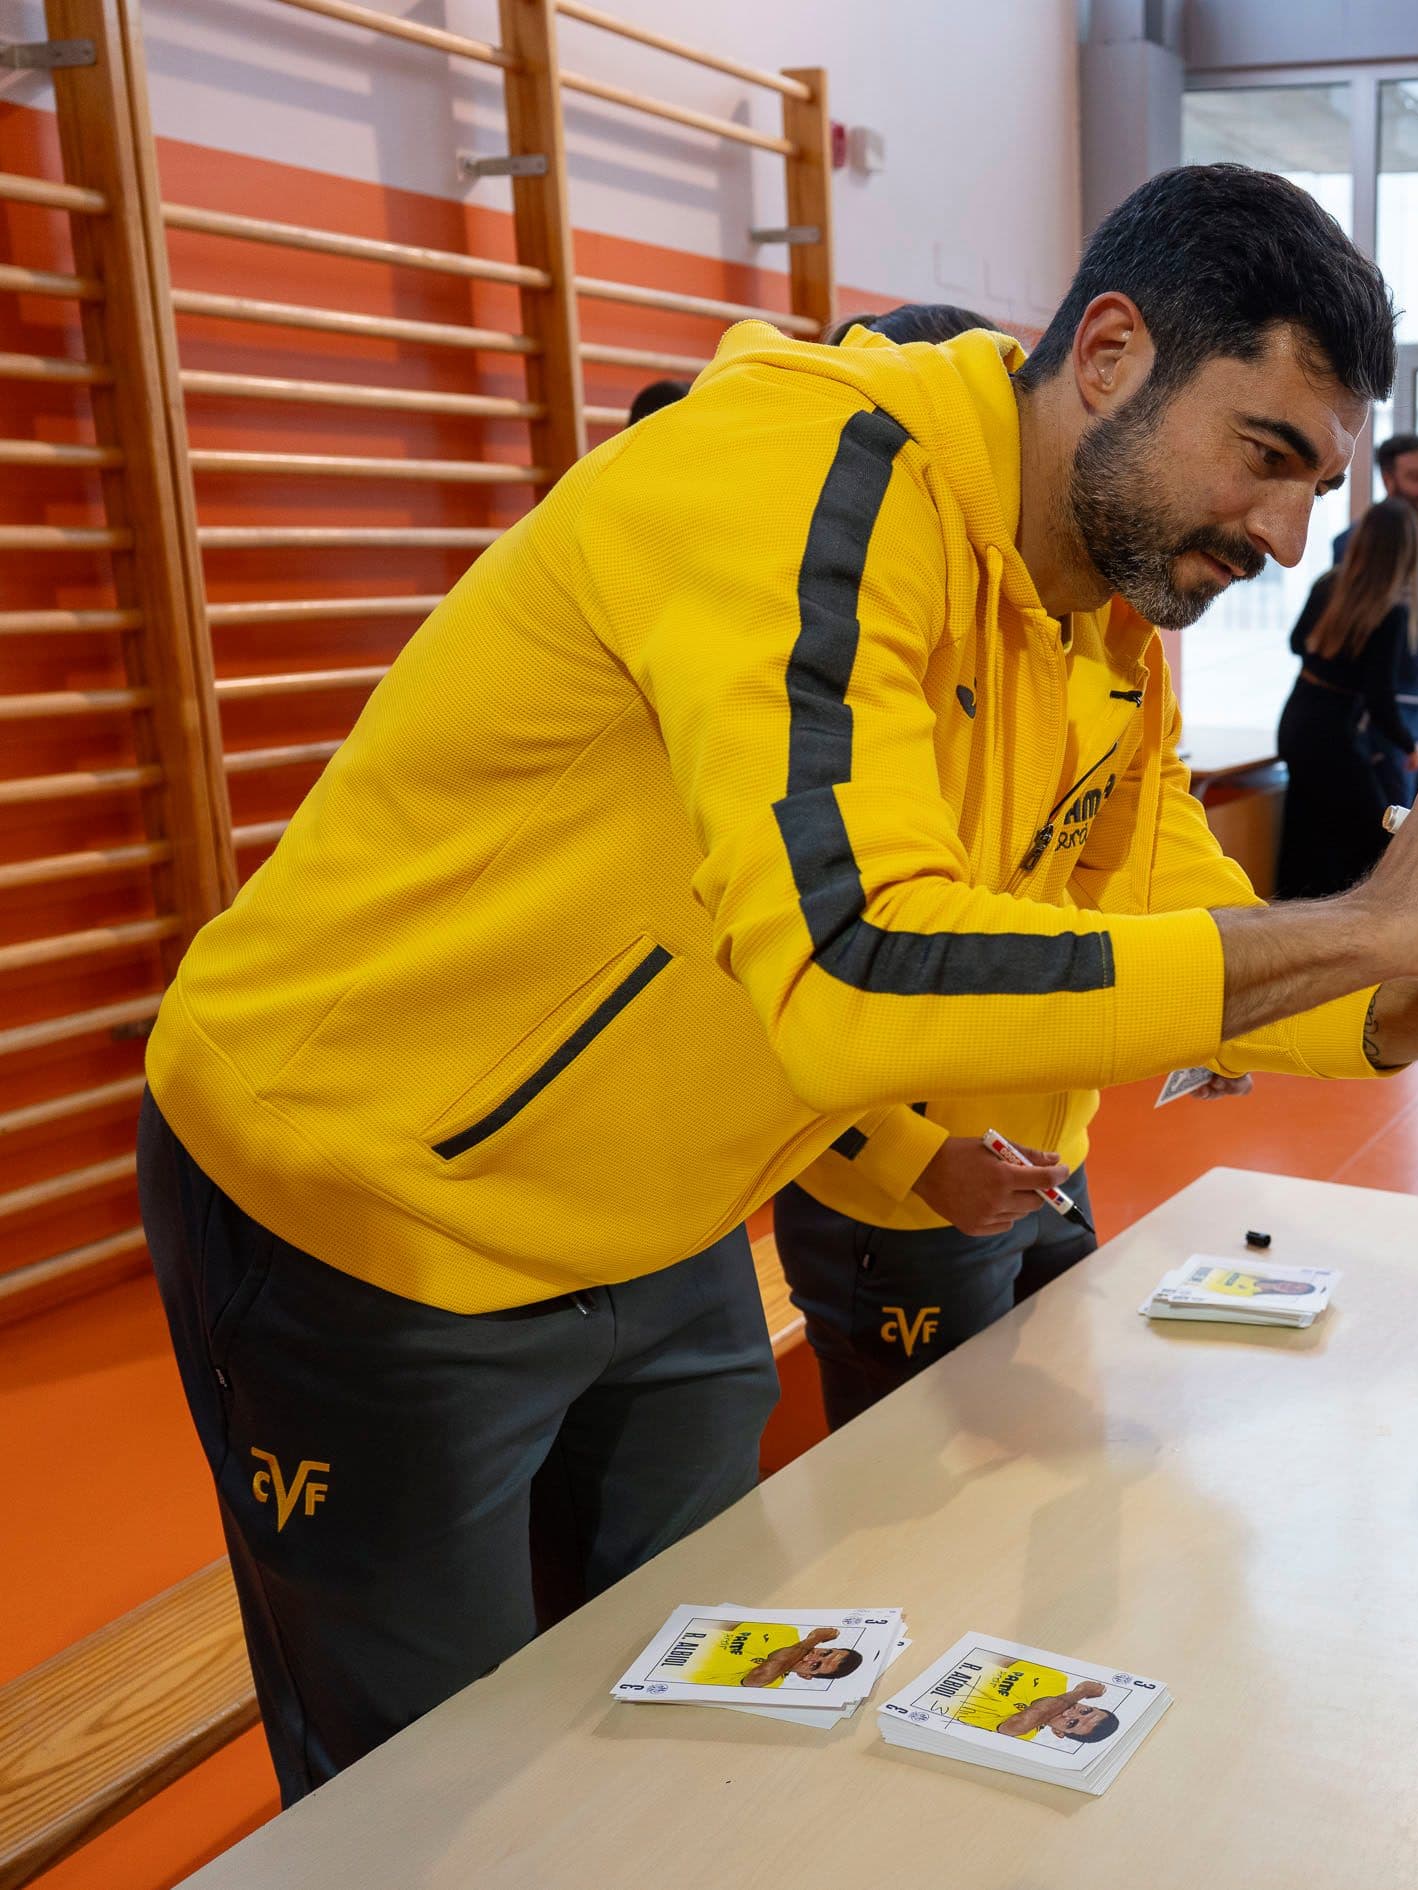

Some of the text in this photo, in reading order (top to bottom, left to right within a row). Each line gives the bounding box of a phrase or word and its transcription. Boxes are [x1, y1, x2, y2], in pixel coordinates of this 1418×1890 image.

[660, 1641, 700, 1667] ALBIOL
[619, 1683, 645, 1691] 3
[930, 1670, 972, 1698] ALBIOL
[998, 1671, 1025, 1697] PAME
[1133, 1680, 1156, 1690] 3
[886, 1703, 909, 1714] 3
